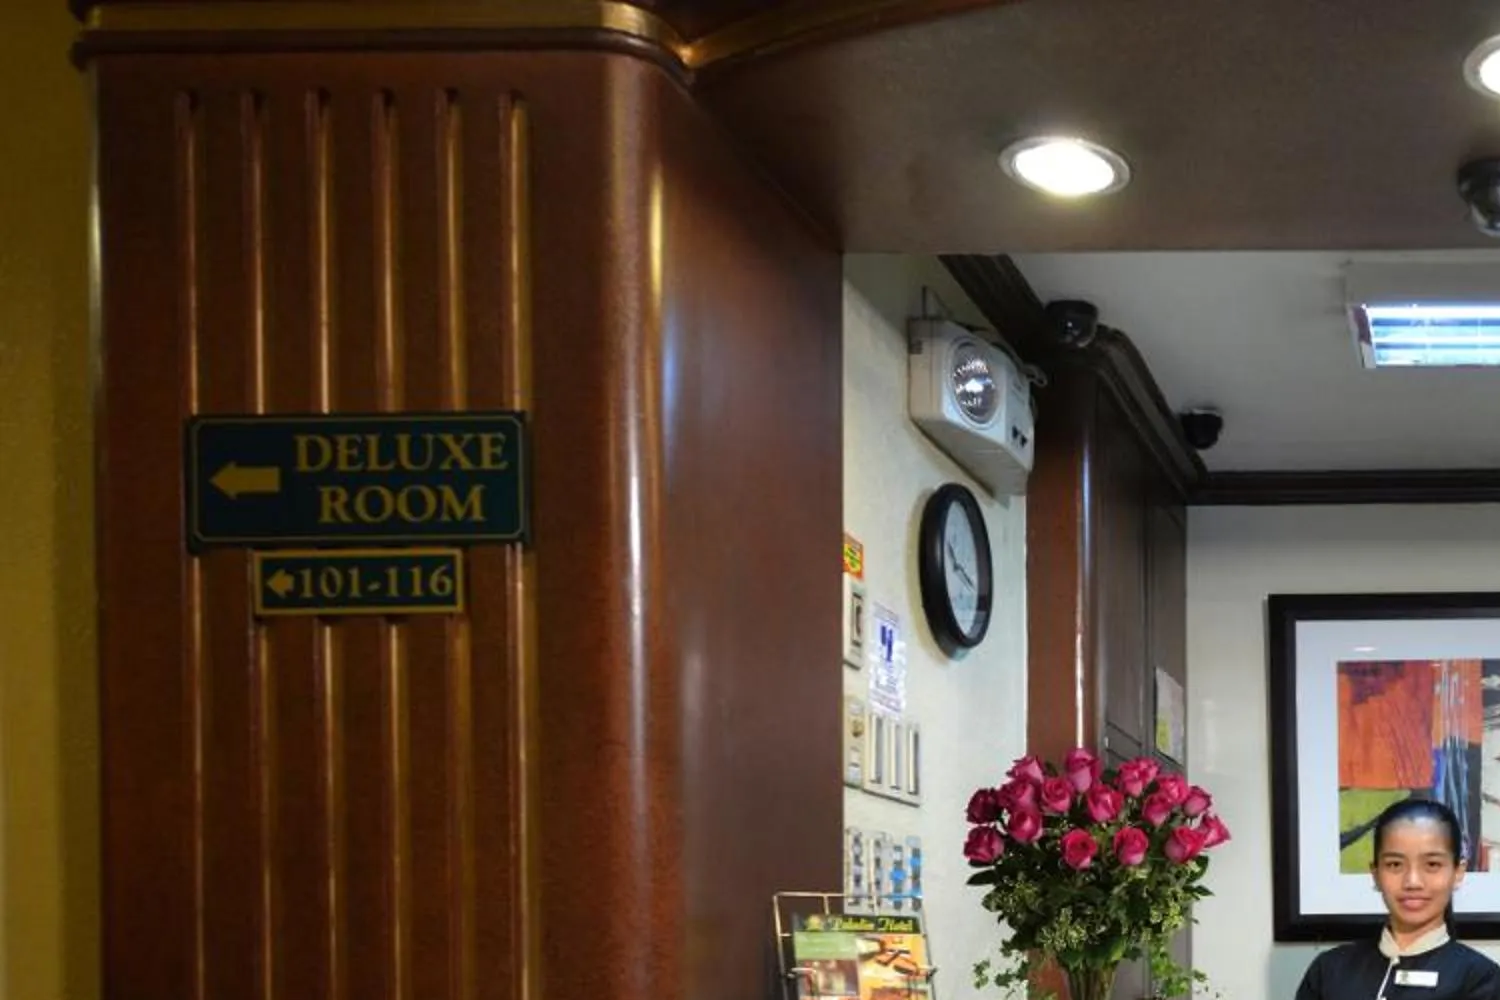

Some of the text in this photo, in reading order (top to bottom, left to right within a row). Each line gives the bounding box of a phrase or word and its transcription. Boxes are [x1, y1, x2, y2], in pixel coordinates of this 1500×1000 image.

[293, 432, 509, 473] DELUXE
[317, 483, 488, 524] ROOM
[299, 564, 453, 599] 101-116
